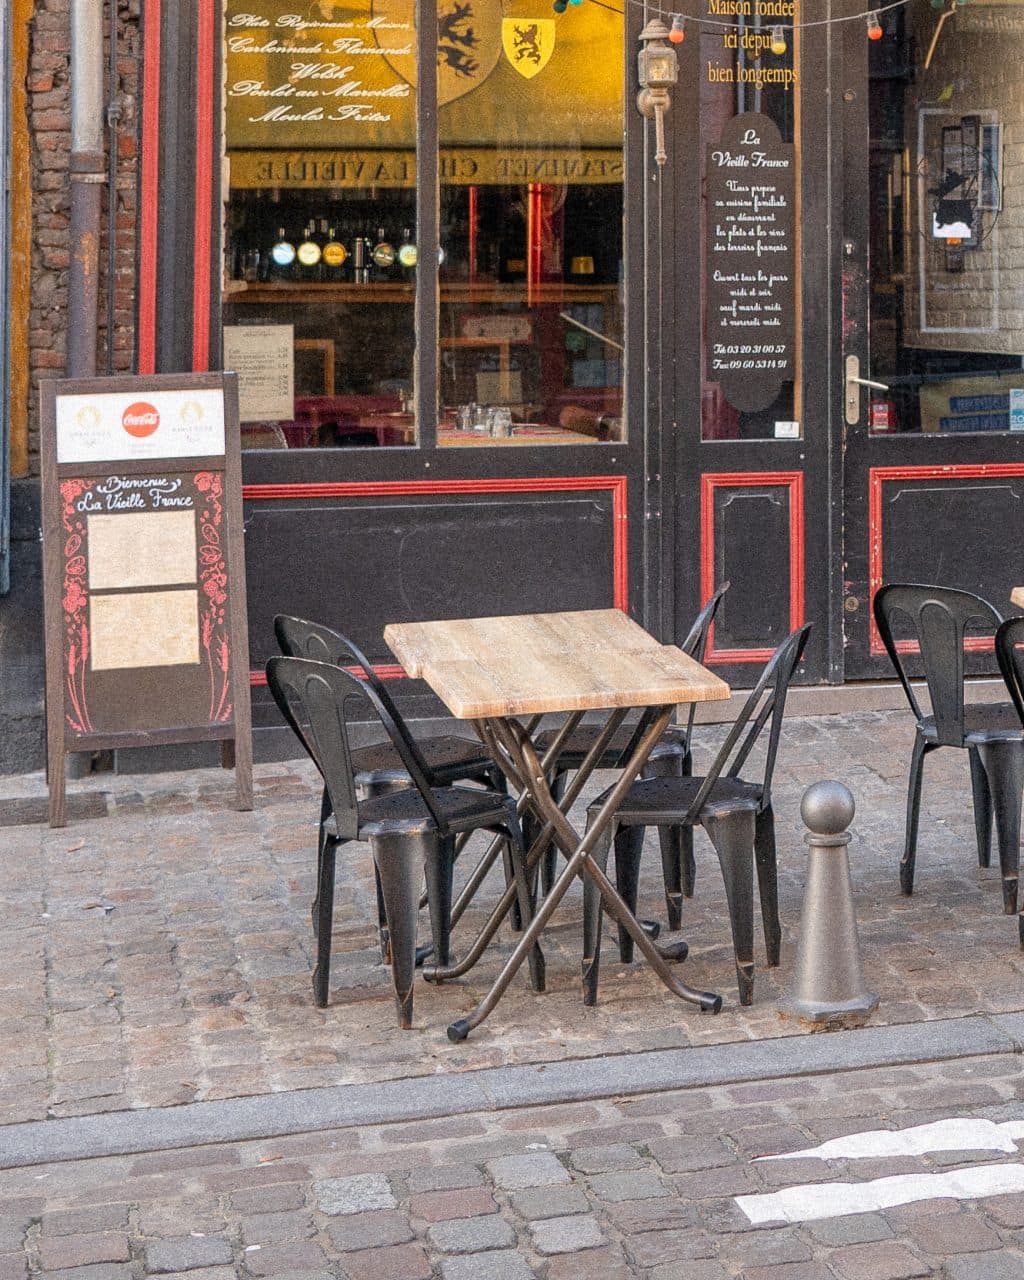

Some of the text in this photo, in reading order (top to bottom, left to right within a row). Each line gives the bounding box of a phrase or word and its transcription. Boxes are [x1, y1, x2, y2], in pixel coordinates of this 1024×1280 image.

[228, 13, 270, 28] Plats
[357, 17, 410, 29] Maison
[228, 36, 412, 56] Carbonnade Flamande
[724, 27, 737, 49] ici
[290, 62, 355, 80] Welsh
[708, 61, 798, 90] bien longtemps
[228, 79, 297, 97] Poulet
[296, 89, 320, 97] au
[249, 104, 392, 122] Moules Frites
[740, 129, 760, 144] La
[712, 151, 789, 168] Vieille France
[768, 274, 788, 287] jours
[727, 345, 738, 354] 03
[740, 345, 751, 354] 20
[752, 345, 762, 354] 31
[762, 345, 774, 354] 00
[775, 345, 786, 354] 57
[729, 360, 741, 369] 09
[777, 360, 787, 369] 91
[99, 476, 180, 493] Bienvenue
[77, 489, 194, 511] La Vieille France
